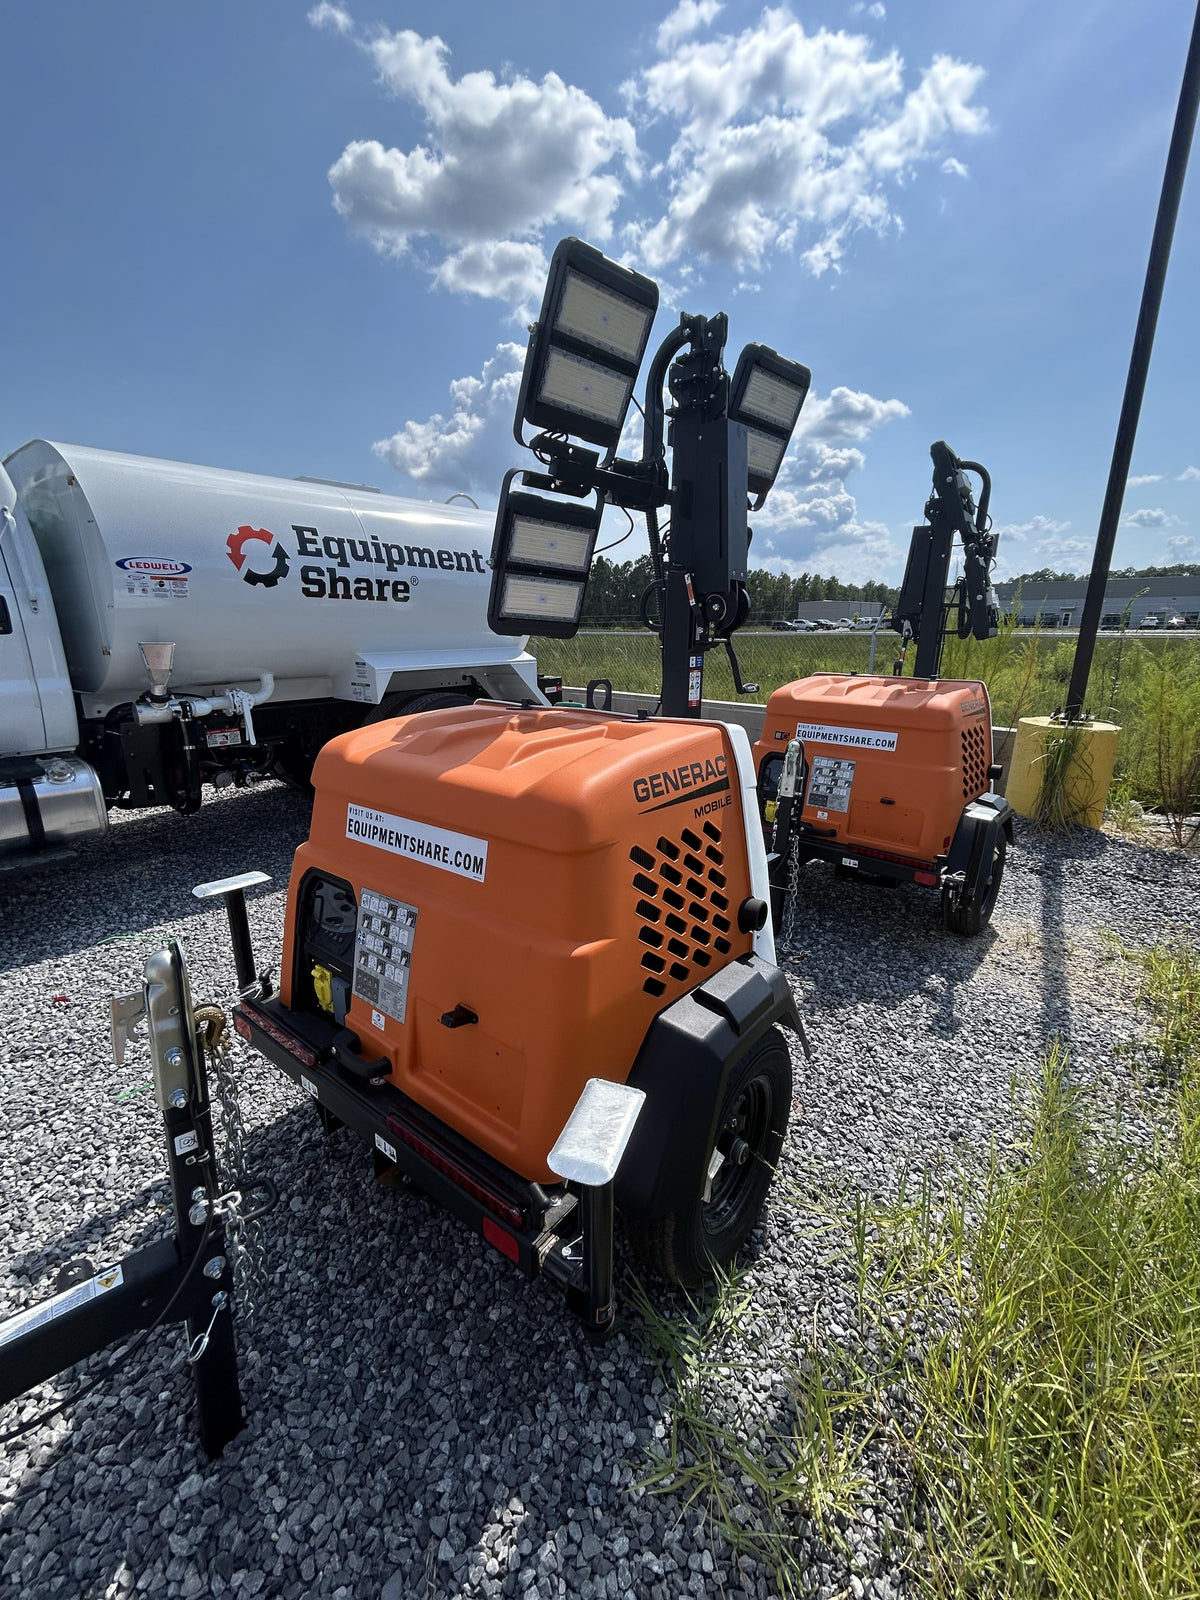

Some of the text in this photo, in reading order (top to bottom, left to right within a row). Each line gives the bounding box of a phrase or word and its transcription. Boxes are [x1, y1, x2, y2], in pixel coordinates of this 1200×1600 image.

[291, 525, 486, 574] Equipment
[128, 561, 181, 571] LEDWELL
[796, 729, 896, 749] EQUIPMENTSHARE.COM
[633, 755, 728, 803] GENERAC
[349, 806, 385, 822] VISIT US AT:
[693, 795, 732, 819] MOBILE
[347, 818, 484, 875] EQUIPMENTSHARE.COM
